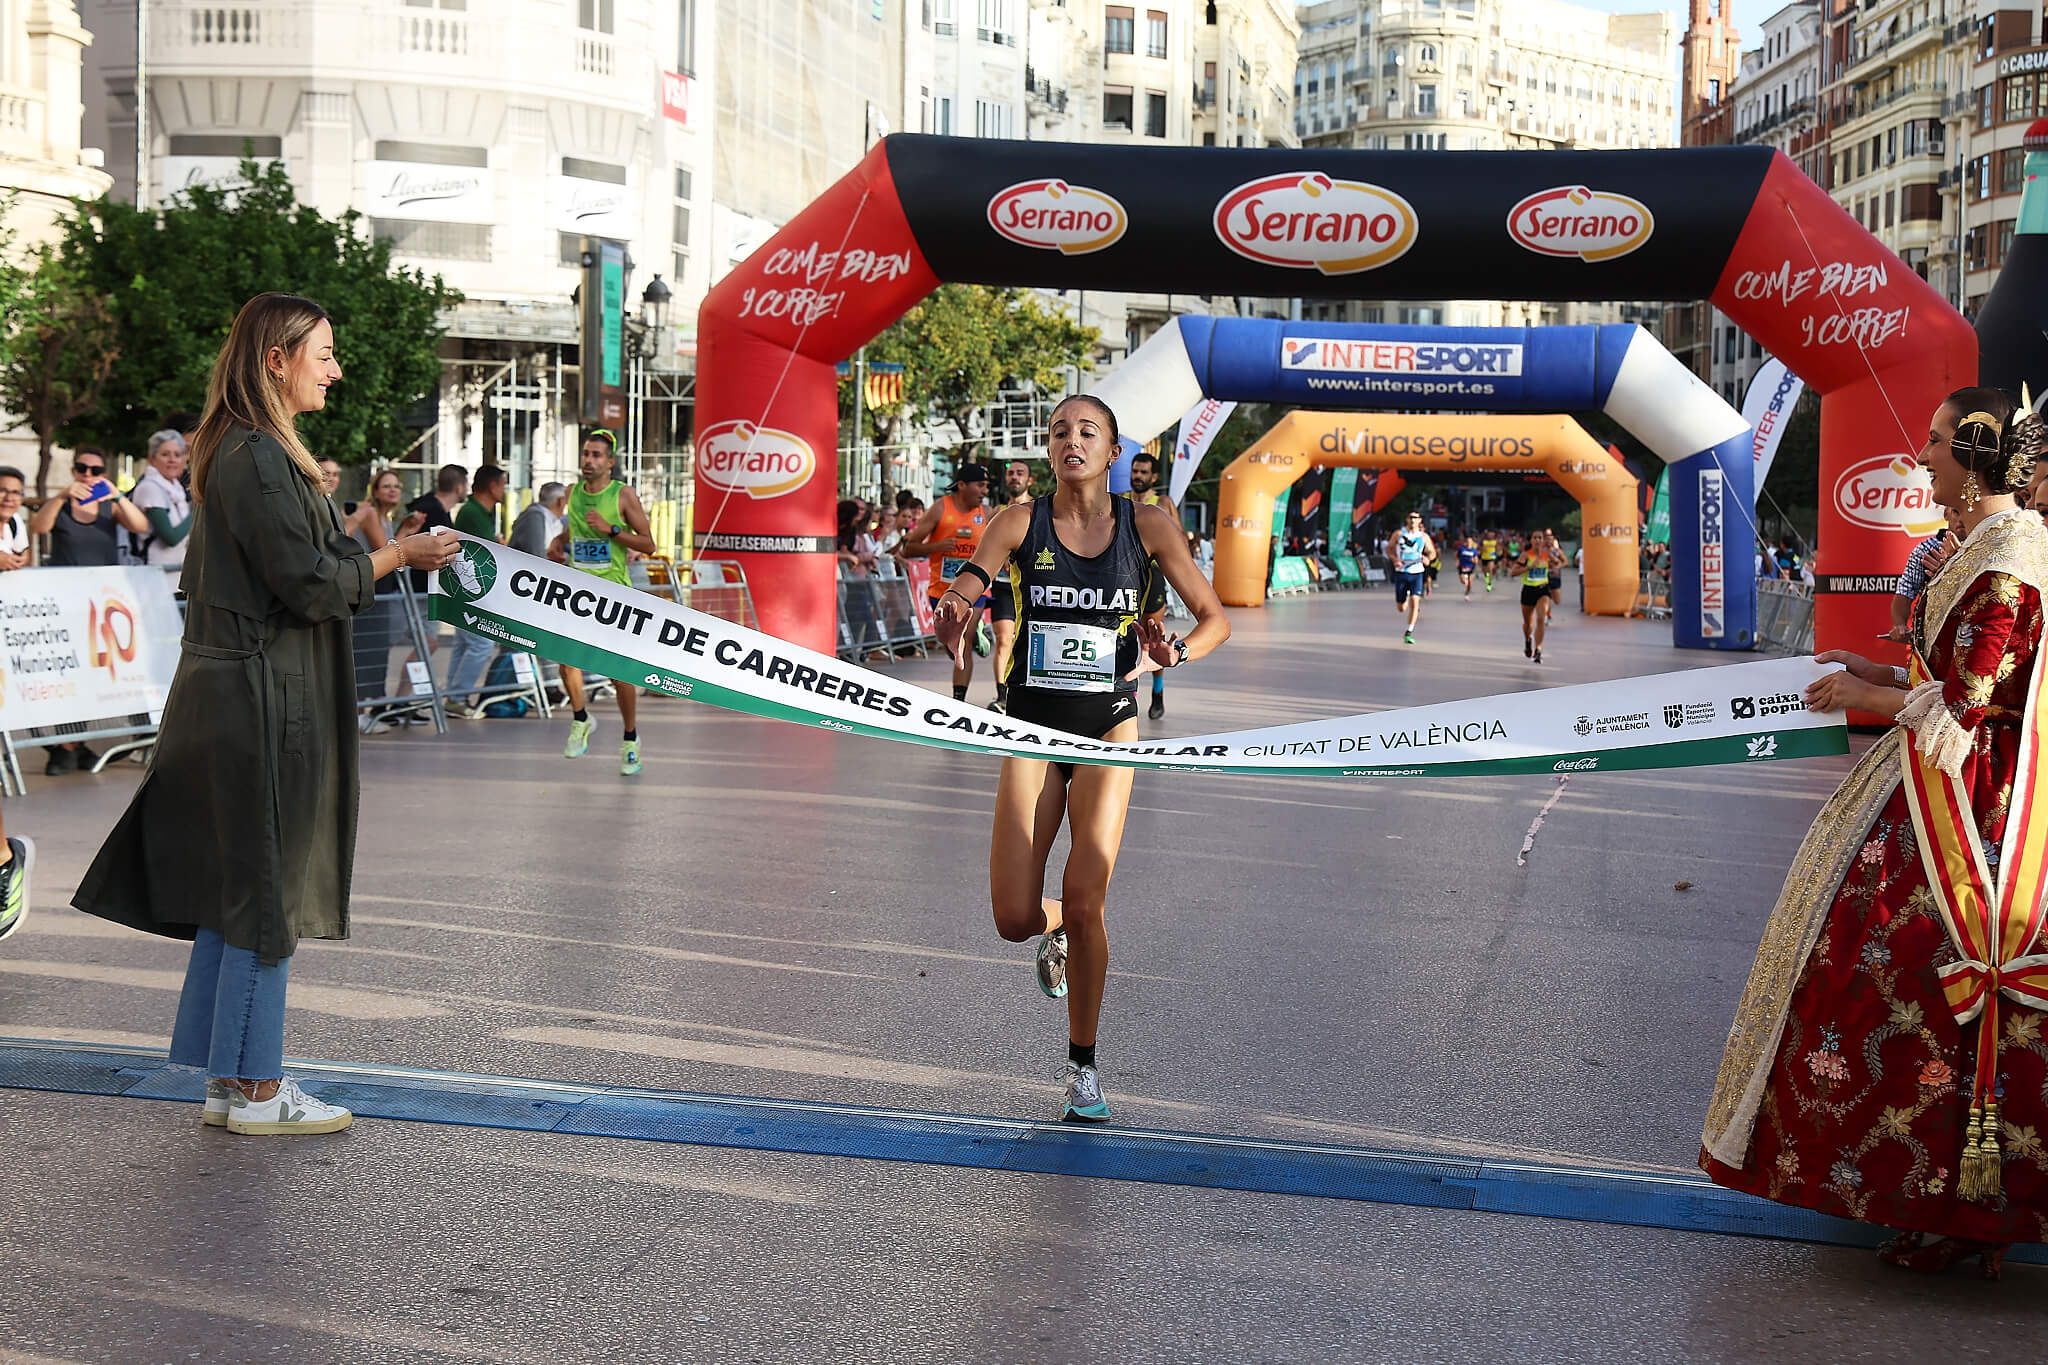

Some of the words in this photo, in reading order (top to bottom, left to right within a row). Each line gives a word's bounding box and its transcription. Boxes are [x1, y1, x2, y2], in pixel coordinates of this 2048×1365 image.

[1003, 199, 1112, 232] Serrano
[1236, 199, 1396, 243] Serrano
[1523, 207, 1638, 237] Serrano
[763, 240, 840, 285] COME
[838, 248, 911, 283] BIEN
[1734, 260, 1816, 308] COME
[1814, 260, 1888, 298] BIEN
[754, 287, 846, 326] CORRE!
[1818, 305, 1910, 350] CORRE!
[1321, 343, 1512, 372] INTERSPORT
[1307, 377, 1494, 395] www.intersport.es
[1186, 398, 1222, 446] INTER
[1753, 367, 1797, 462] INTERSPOR
[704, 441, 802, 473] Serrano
[1248, 452, 1293, 465] divina
[1320, 427, 1534, 463] divinaseguros
[1559, 459, 1606, 473] divina
[1846, 478, 1940, 509] Serra
[1589, 522, 1632, 538] divina
[1701, 476, 1722, 609] INTERSPORT
[574, 543, 608, 557] 2124
[1030, 585, 1136, 612] REDOLAT
[509, 569, 653, 635] CIRCUIT
[658, 618, 709, 656] DE
[714, 639, 911, 718] CARRERES
[923, 708, 1042, 746] CAIXA
[1047, 739, 1229, 757] POPULAR
[1243, 739, 1332, 757] CIUTAT
[1339, 736, 1372, 753] DE
[1379, 719, 1507, 750] VALÈNCIA
[1061, 638, 1097, 662] 25
[1759, 692, 1799, 706] caixa
[1596, 713, 1649, 725] AJUNTAMENT
[1596, 726, 1608, 734] DE
